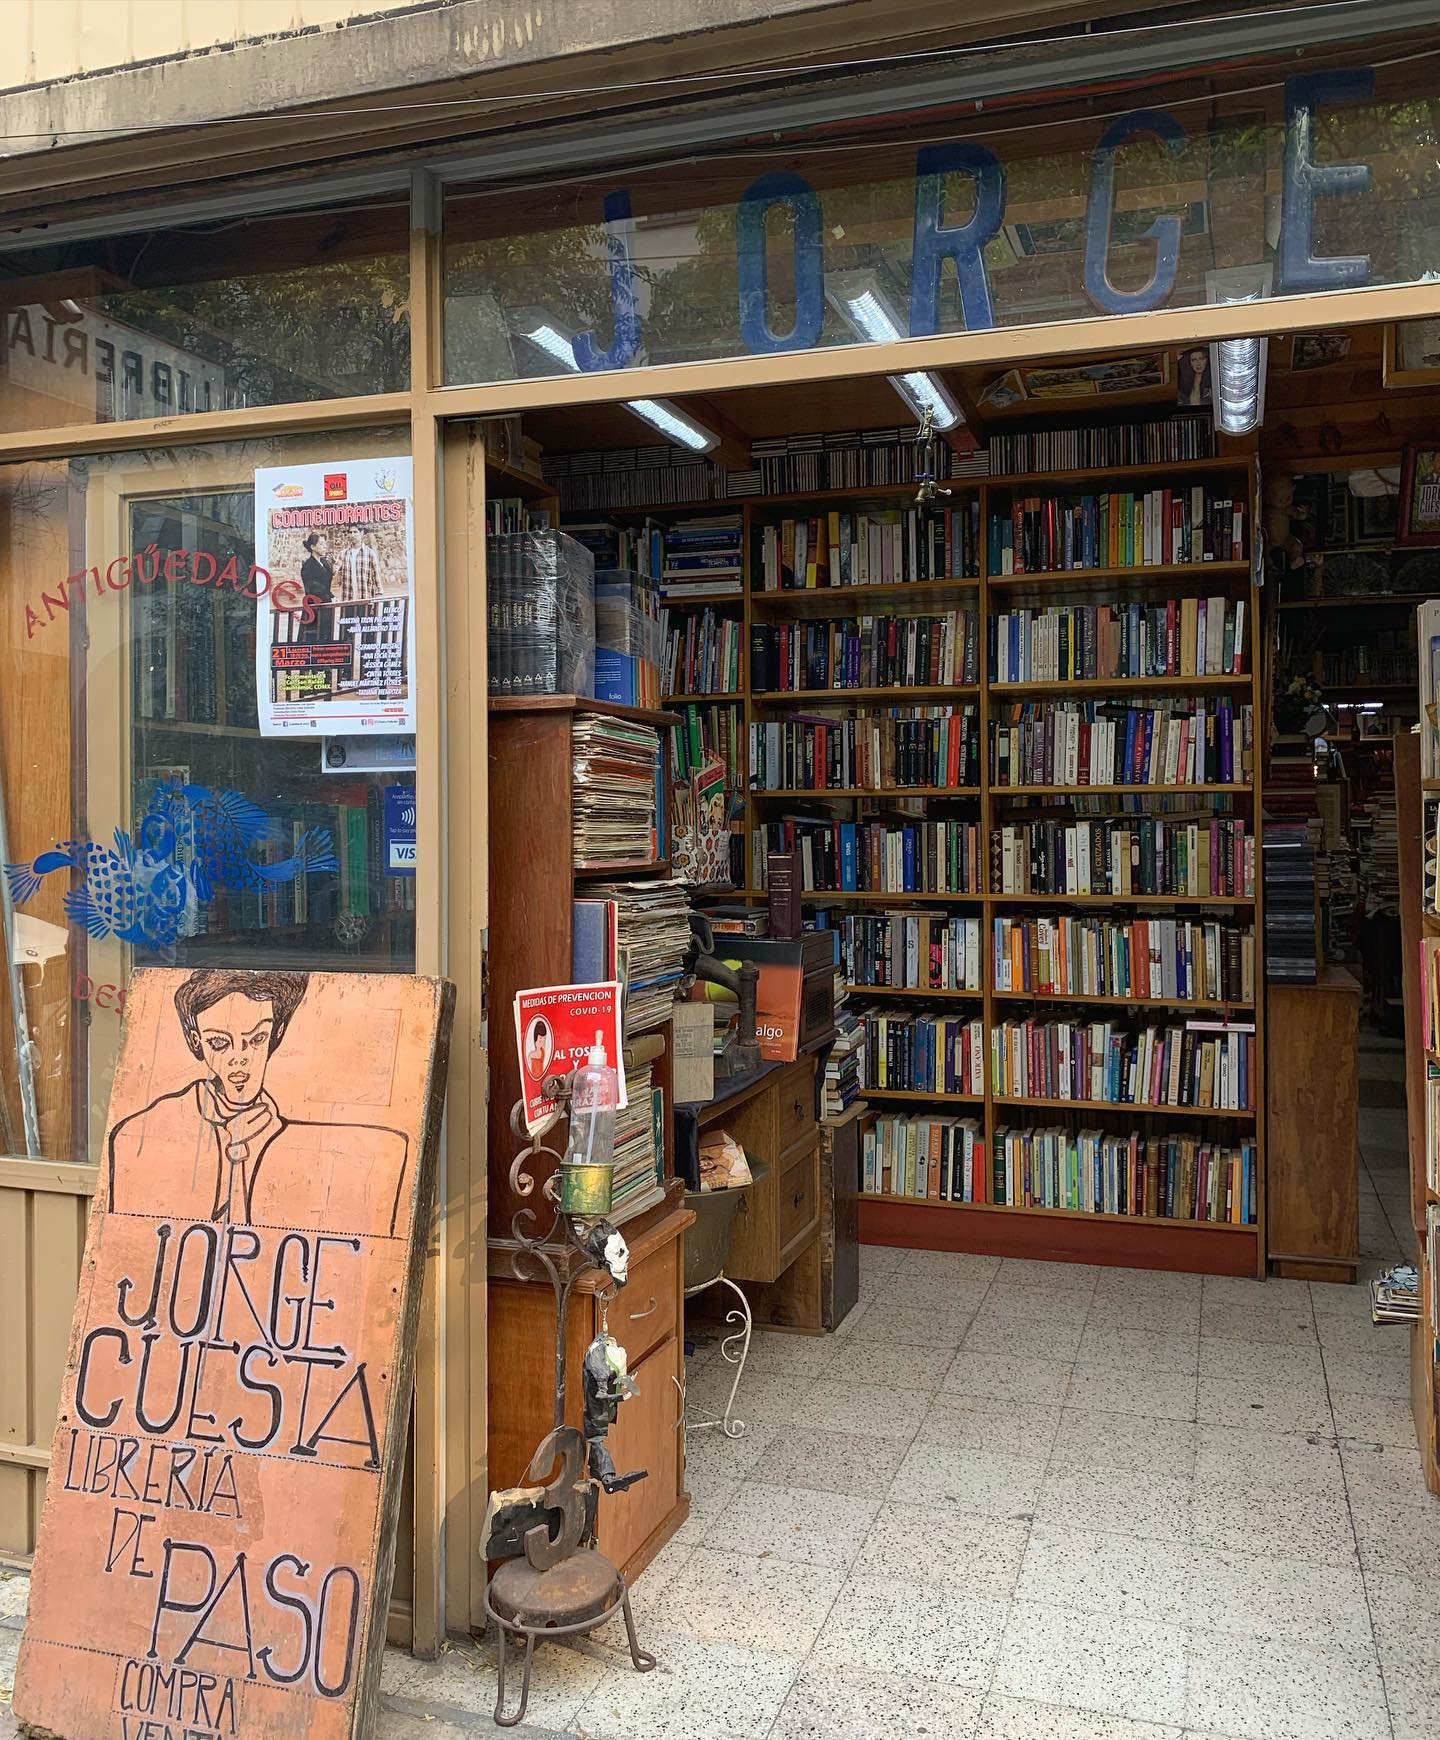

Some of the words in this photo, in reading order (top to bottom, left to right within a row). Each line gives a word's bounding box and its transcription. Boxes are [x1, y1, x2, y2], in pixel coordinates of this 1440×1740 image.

[572, 68, 1377, 373] JORGE
[272, 503, 401, 529] CONMEMORANTES
[272, 648, 286, 658] 21
[608, 692, 622, 700] folio
[395, 848, 416, 859] VIS
[1038, 923, 1046, 946] Covey
[522, 995, 547, 1008] MEDIDAS
[548, 994, 557, 1005] DE
[558, 991, 612, 1003] PREVENCION
[570, 1005, 612, 1016] COVID-19
[553, 1048, 566, 1061] AL
[117, 1223, 360, 1357] JORGE
[76, 1326, 382, 1470] CUESTA
[63, 1428, 242, 1519] LIBRERÍA
[105, 1507, 156, 1577] DE
[146, 1538, 360, 1697] PASO
[120, 1659, 236, 1735] COMPRA
